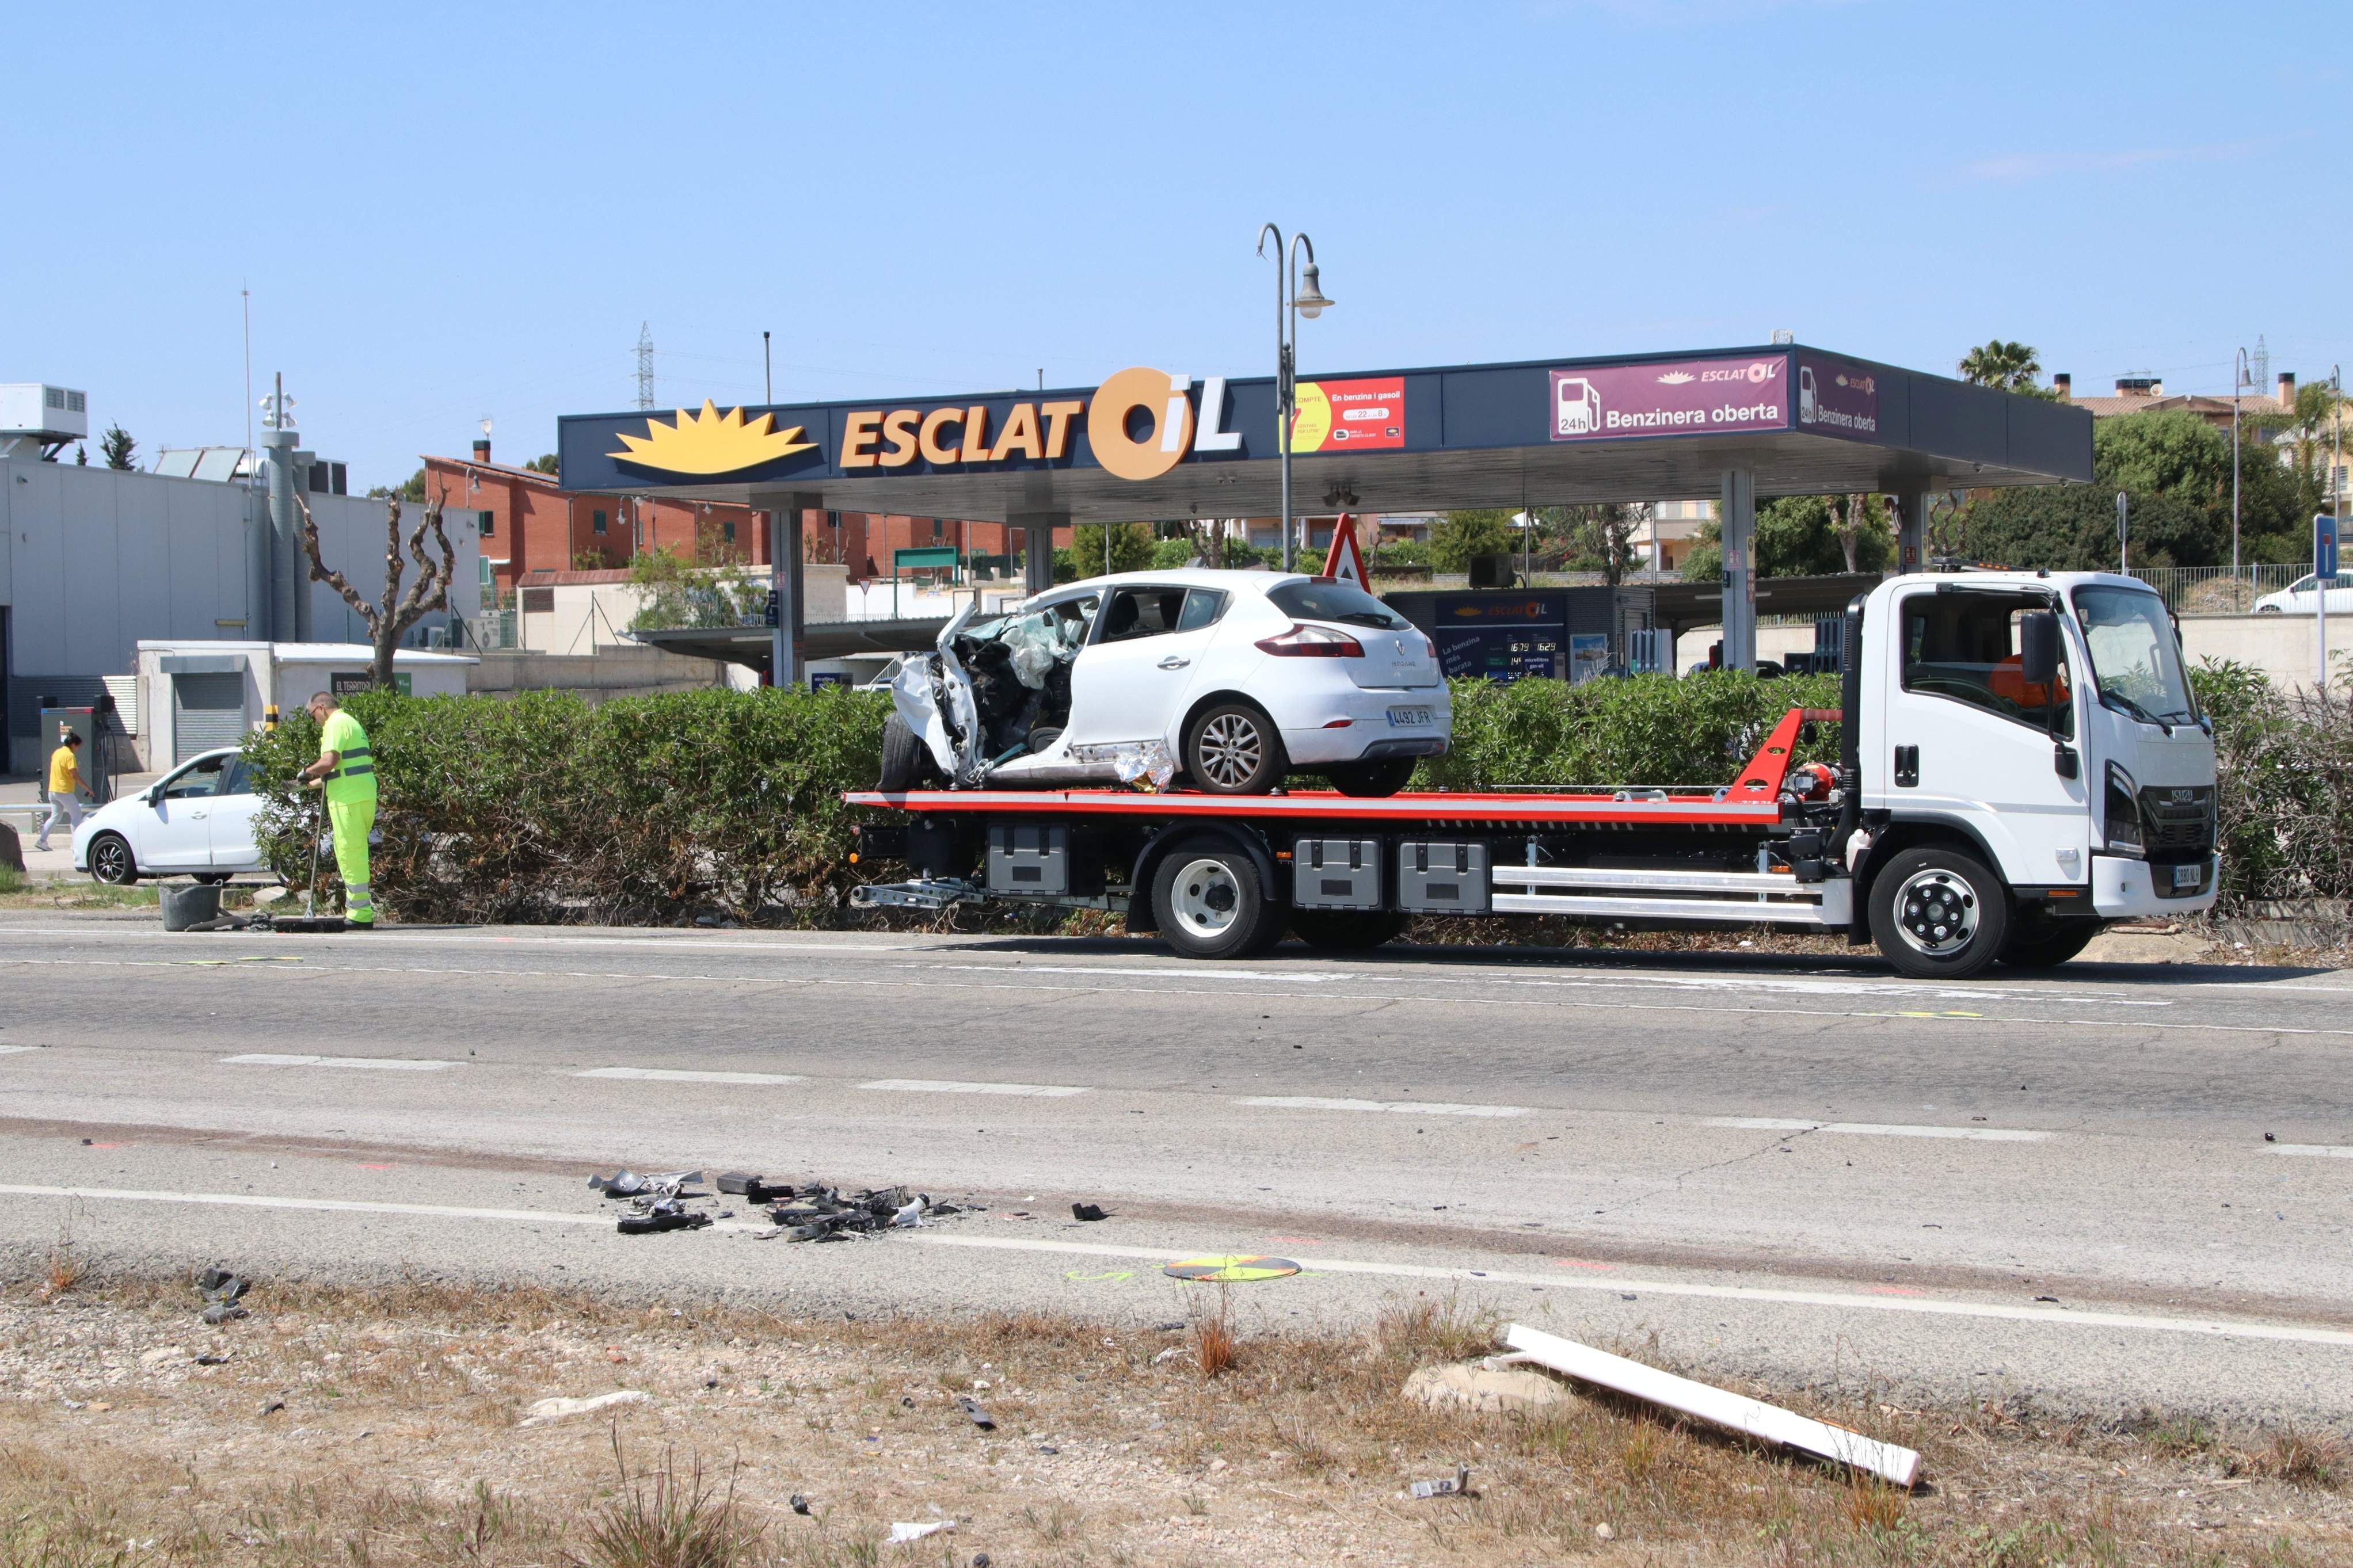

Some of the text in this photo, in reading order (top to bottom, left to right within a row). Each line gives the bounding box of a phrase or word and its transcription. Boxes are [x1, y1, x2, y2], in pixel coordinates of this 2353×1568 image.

[1701, 369, 1747, 383] ESCLAT
[1850, 377, 1866, 391] ESCLAT
[1332, 394, 1342, 402] En
[1344, 392, 1372, 401] benzina
[1378, 391, 1400, 400] gasoil
[1606, 403, 1779, 428] Benzinera oberta
[1801, 405, 1813, 422] 24h
[1818, 405, 1875, 432] Benzinera oberta
[1560, 418, 1586, 431] 24h
[839, 401, 1084, 468] ESCLAT
[1488, 606, 1524, 616] ESCLAT
[1442, 635, 1480, 655] La benzina
[1445, 655, 1461, 664] més
[1448, 660, 1472, 674] barata
[336, 681, 343, 690] EL
[1393, 711, 1431, 724] 4492 JFR
[2172, 790, 2193, 803] ISUZU
[2177, 867, 2199, 883] 2880 NLH
